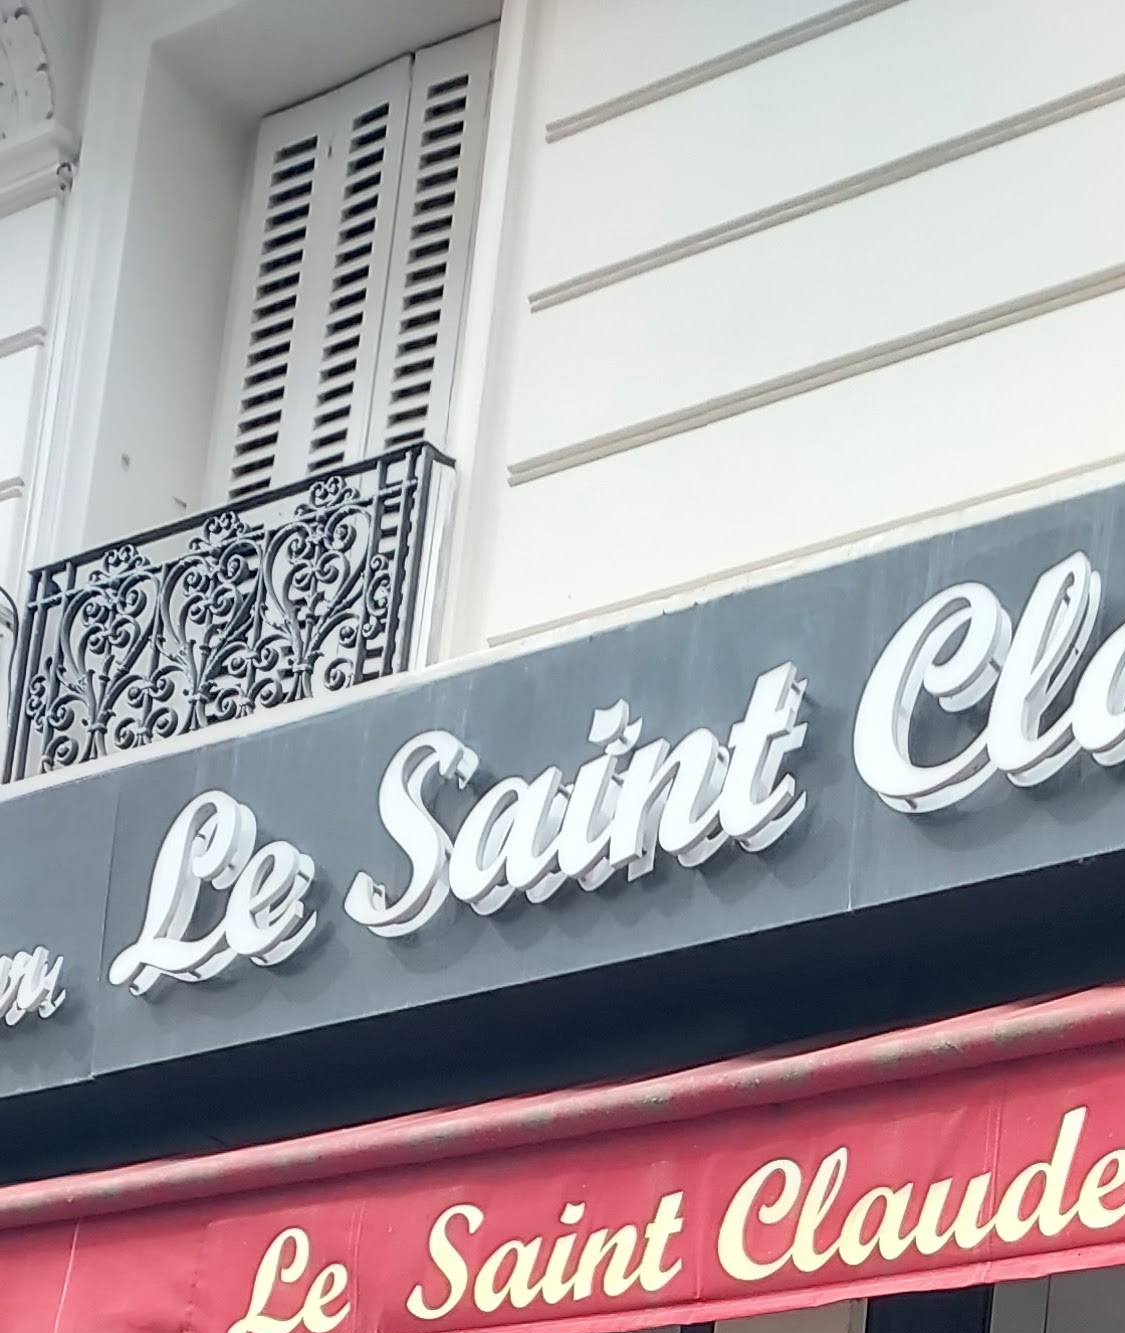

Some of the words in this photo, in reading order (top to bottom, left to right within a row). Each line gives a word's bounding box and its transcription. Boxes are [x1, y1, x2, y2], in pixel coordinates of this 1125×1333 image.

[108, 790, 319, 995] Le
[344, 662, 807, 940] Saint
[406, 1191, 689, 1321] Saint
